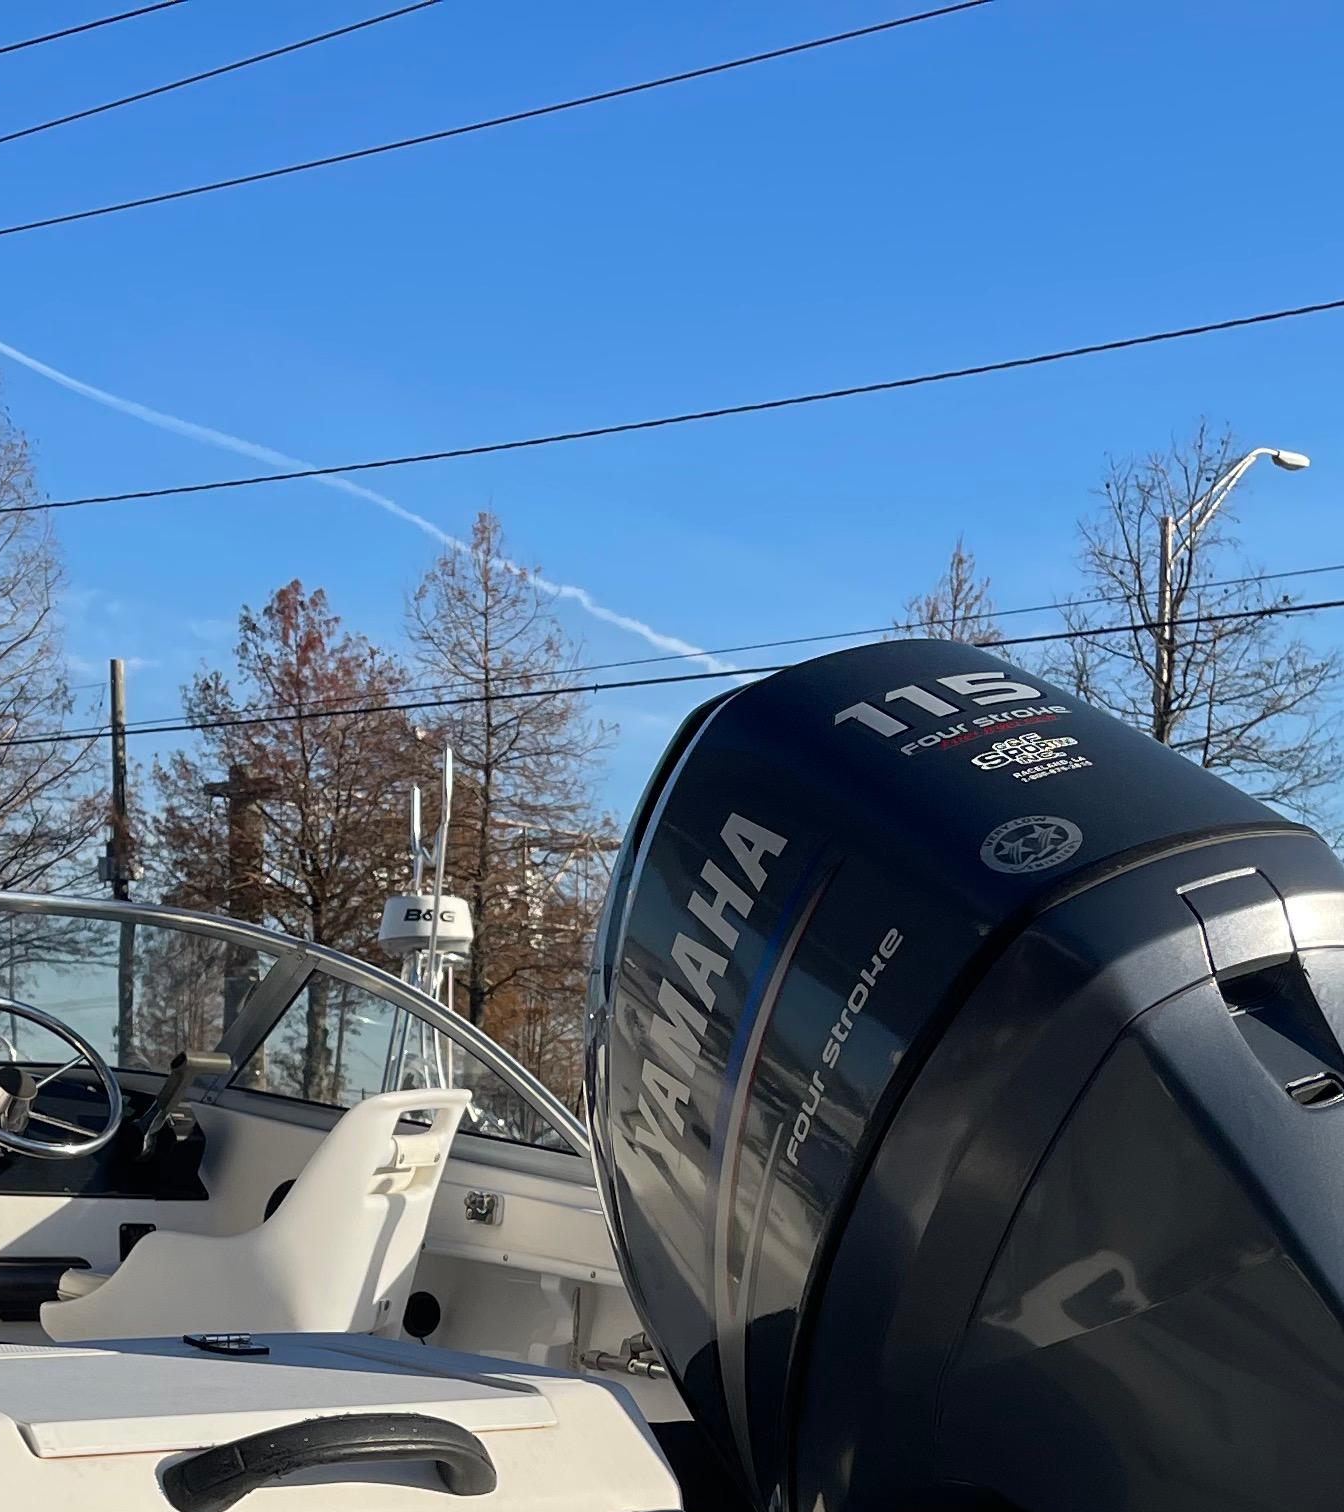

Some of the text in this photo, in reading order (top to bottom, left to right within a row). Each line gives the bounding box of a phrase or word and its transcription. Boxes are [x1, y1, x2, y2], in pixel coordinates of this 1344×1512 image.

[834, 671, 1042, 738] 115
[1015, 817, 1046, 826] LOW
[634, 812, 788, 1166] YAMAHA
